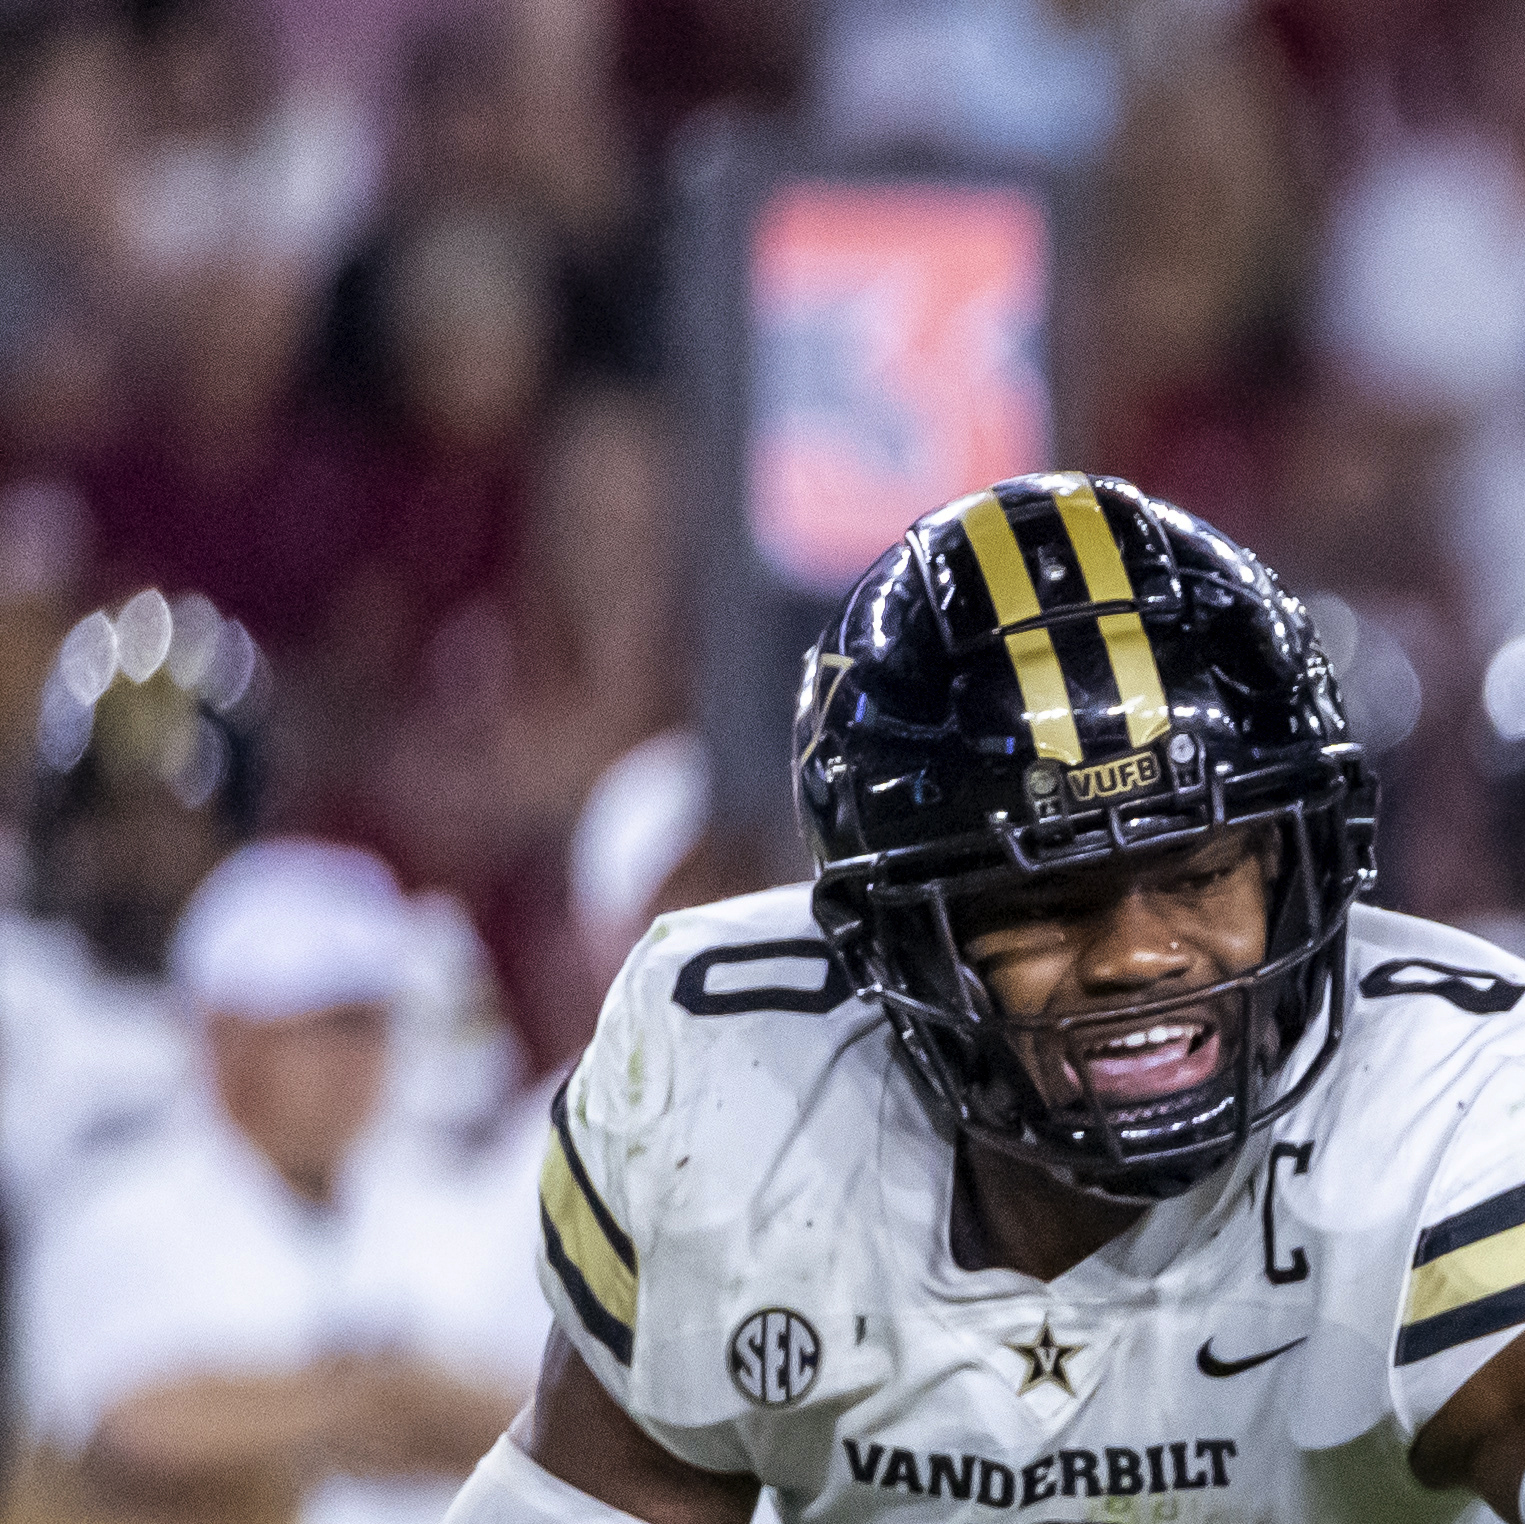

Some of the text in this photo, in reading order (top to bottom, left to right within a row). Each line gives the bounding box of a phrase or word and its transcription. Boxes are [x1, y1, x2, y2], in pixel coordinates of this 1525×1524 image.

[1067, 751, 1161, 801] VUFB
[672, 937, 854, 1017] 0
[1264, 1140, 1313, 1285] C
[731, 1313, 817, 1402] SEC
[842, 1437, 1238, 1511] VANDERBILT
